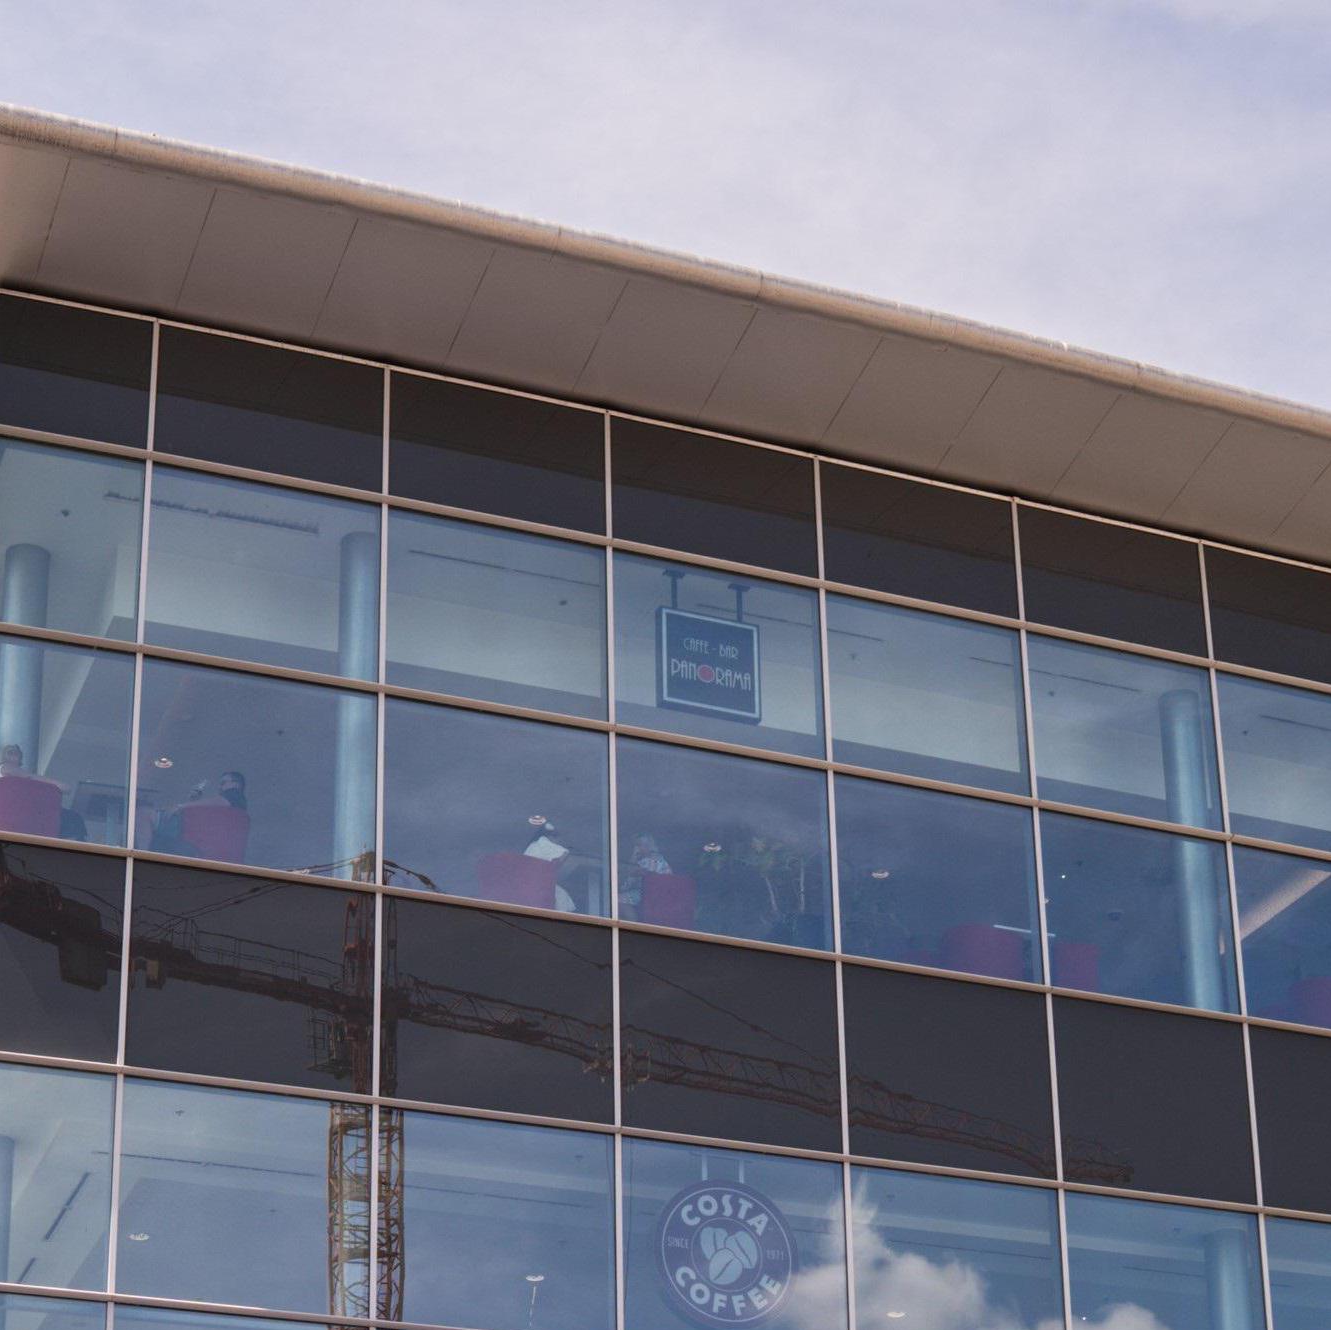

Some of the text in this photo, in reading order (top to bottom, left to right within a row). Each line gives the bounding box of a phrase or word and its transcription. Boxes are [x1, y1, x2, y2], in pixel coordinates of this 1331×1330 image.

[671, 658, 751, 692] PANORAMA
[681, 1194, 768, 1236] COSTA
[675, 1266, 782, 1316] COFFEE
